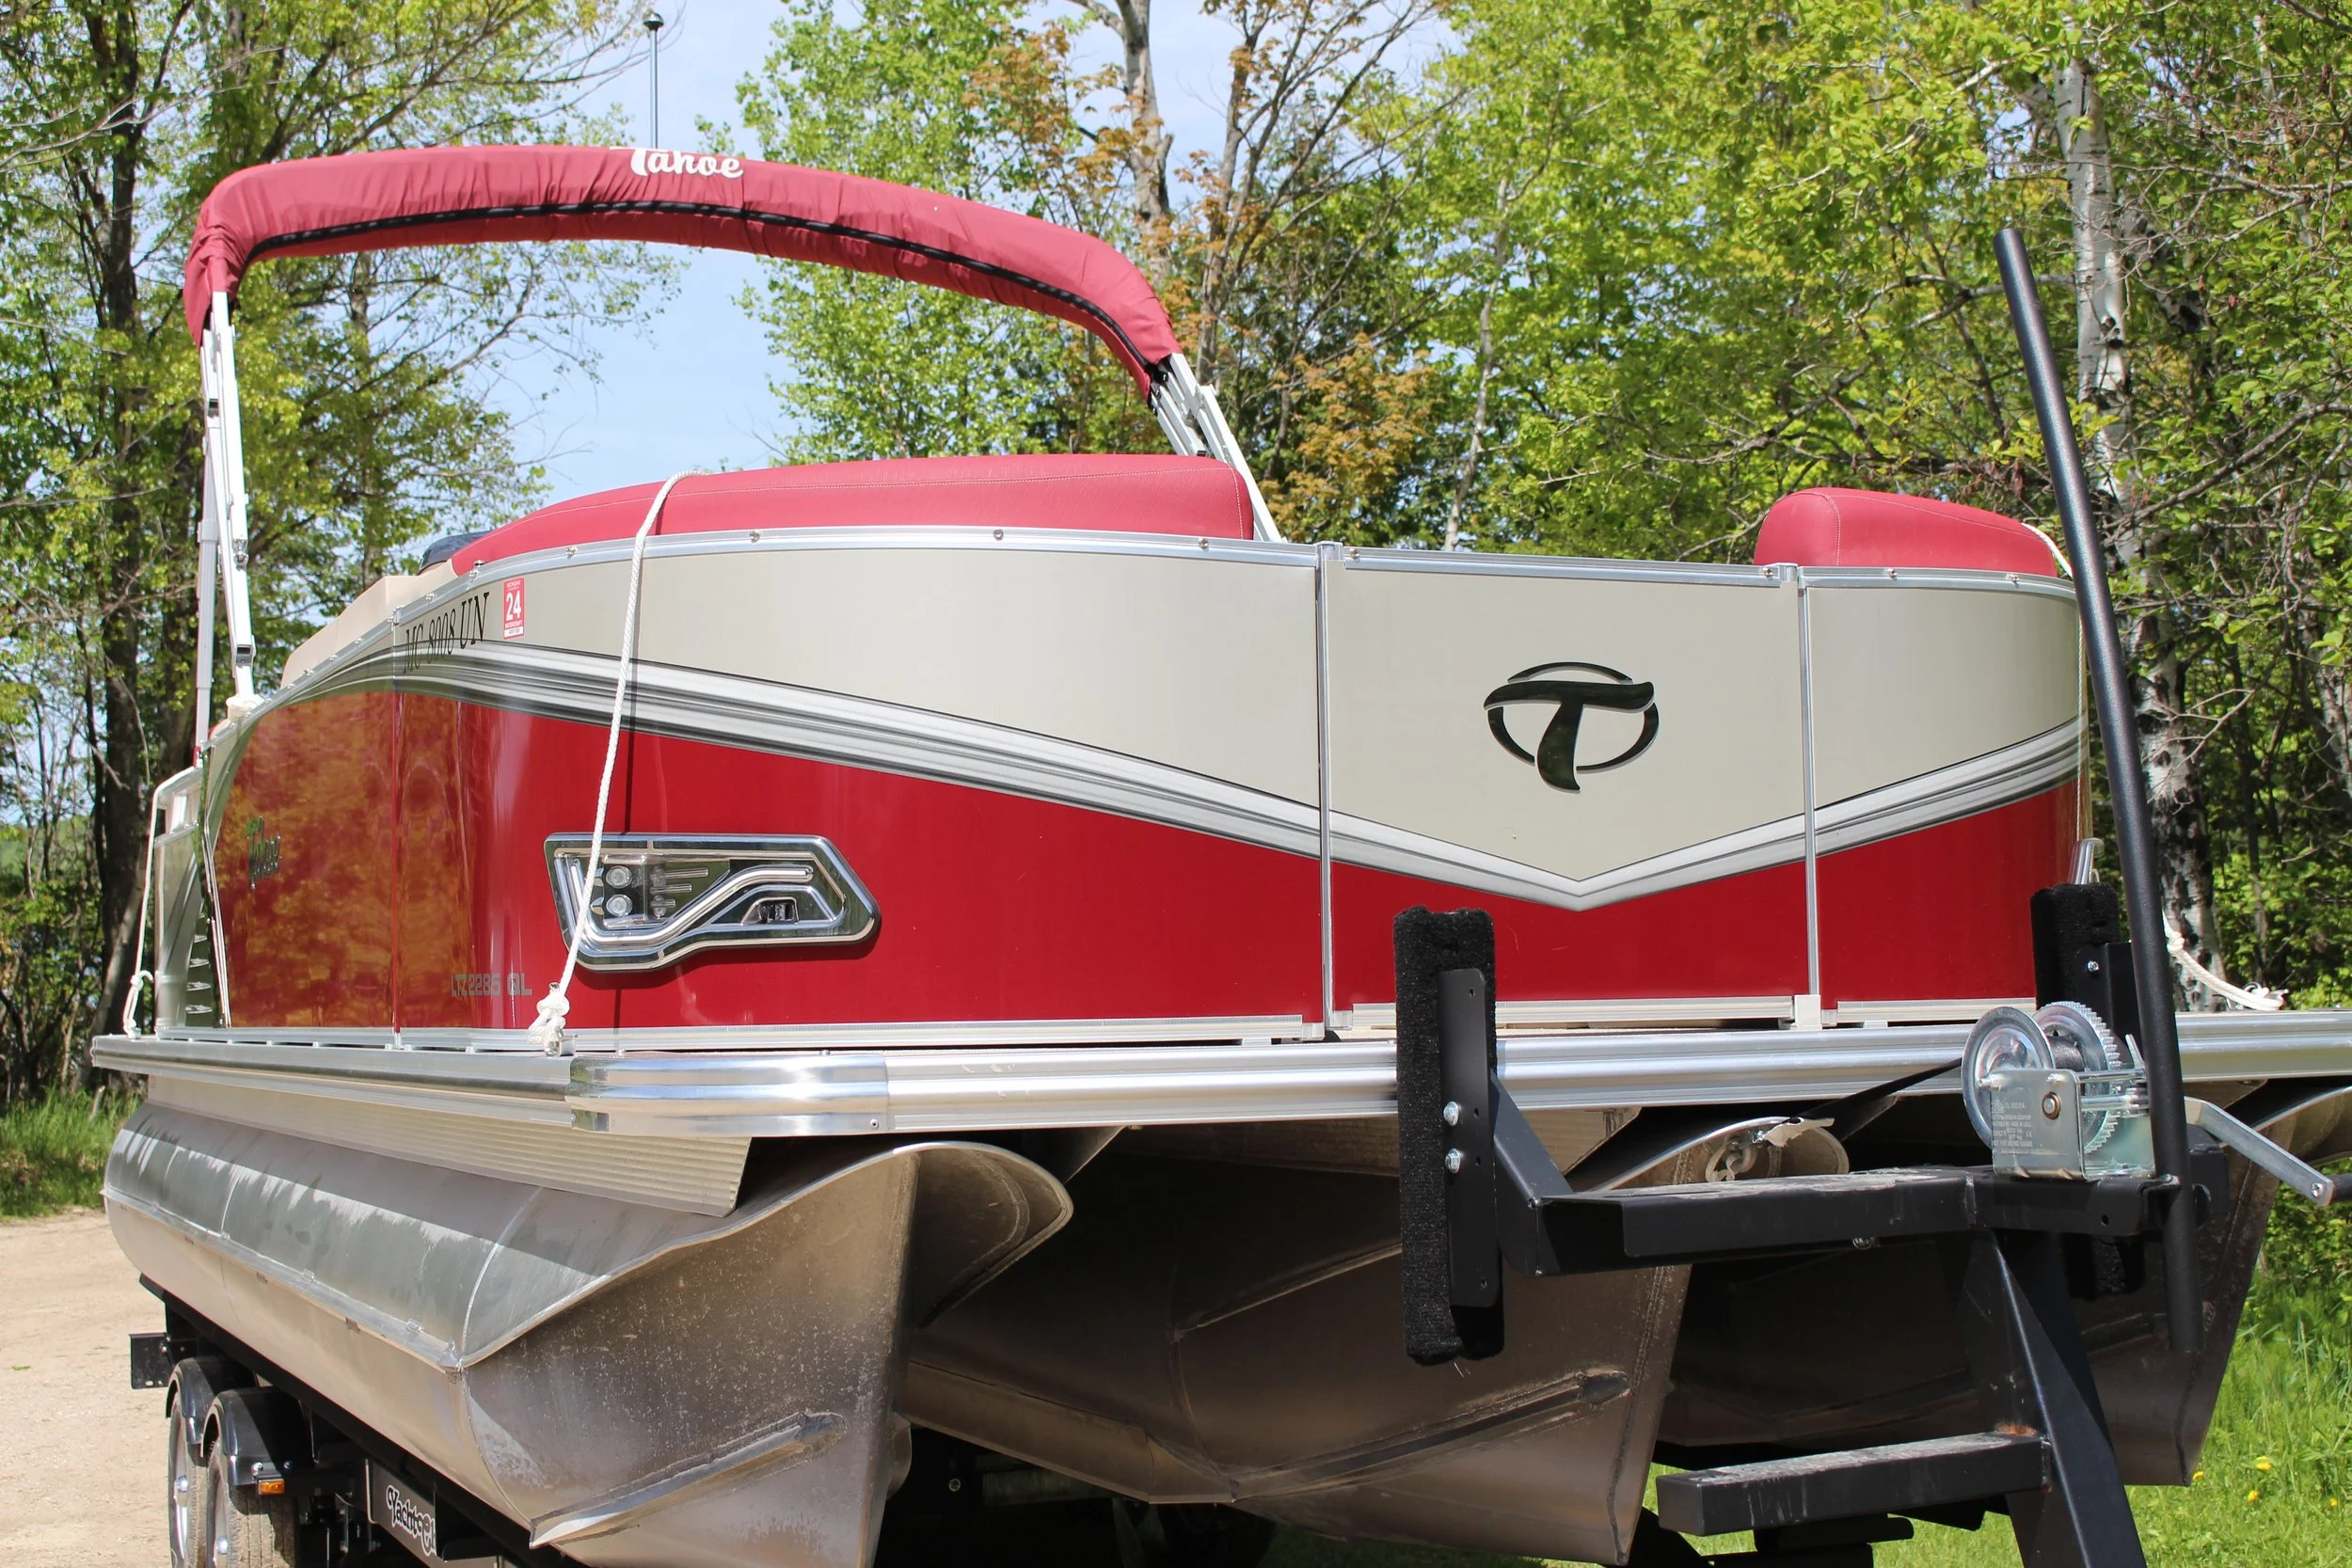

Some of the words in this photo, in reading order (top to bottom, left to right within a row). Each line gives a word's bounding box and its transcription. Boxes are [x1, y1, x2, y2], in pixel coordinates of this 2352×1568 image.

[629, 148, 744, 179] Tahoe
[506, 590, 521, 621] 24
[403, 621, 423, 674] MC
[426, 608, 456, 664] 8008
[460, 592, 489, 649] UN
